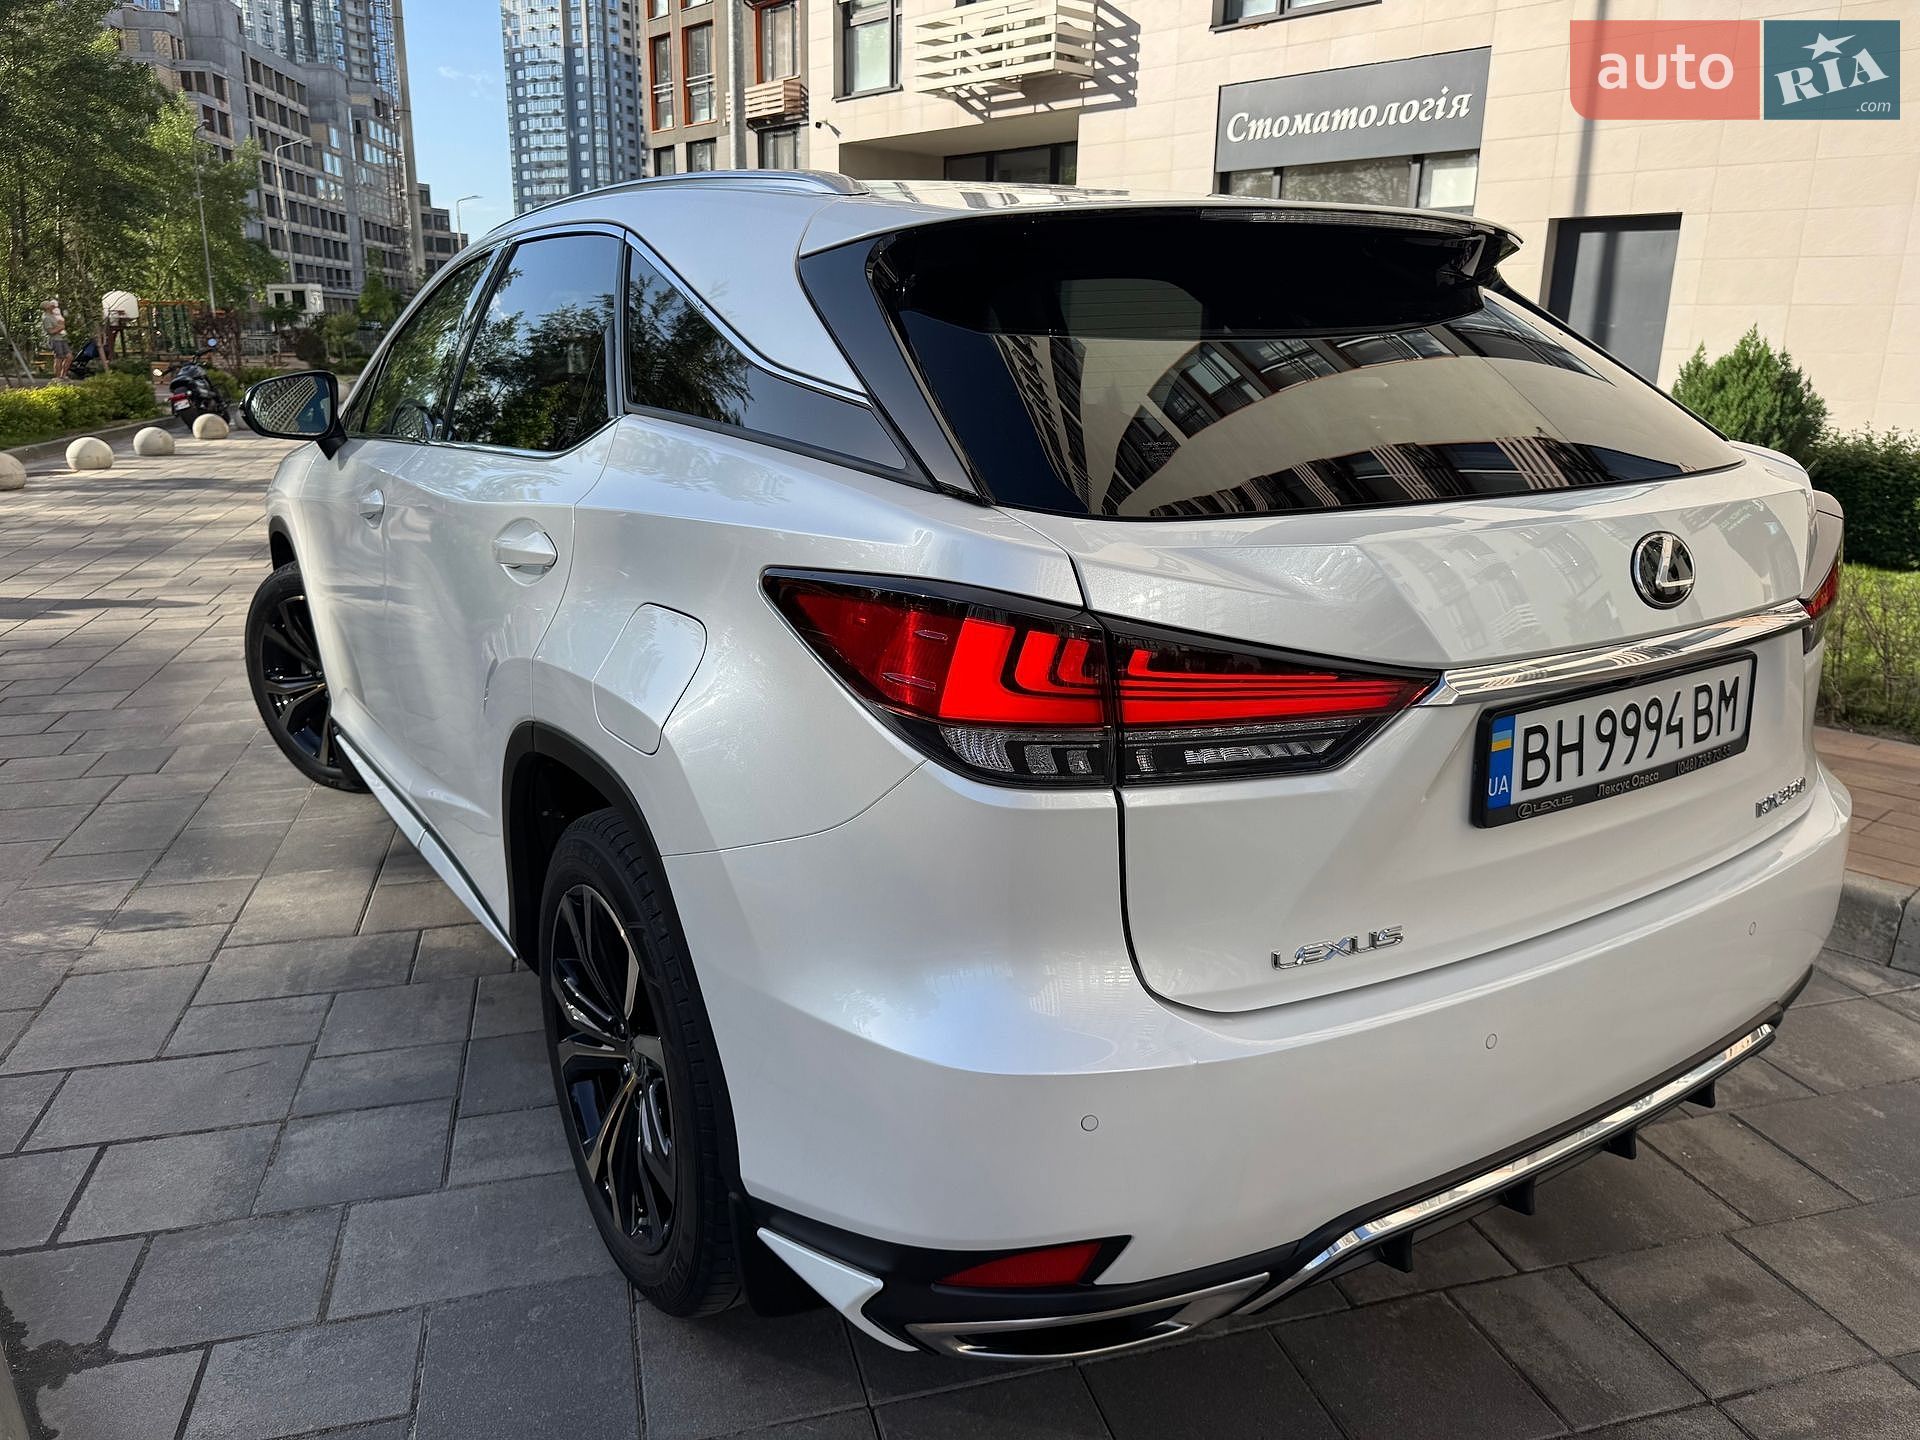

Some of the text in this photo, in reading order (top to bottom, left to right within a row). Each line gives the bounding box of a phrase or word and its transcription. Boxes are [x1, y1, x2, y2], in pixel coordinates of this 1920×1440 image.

[1226, 86, 1474, 142] Стоматологія
[1488, 776, 1509, 797] UA
[1597, 771, 1659, 797] Лексус Одеса
[1533, 795, 1573, 812] LEXUS
[1271, 925, 1404, 970] LEXUS
